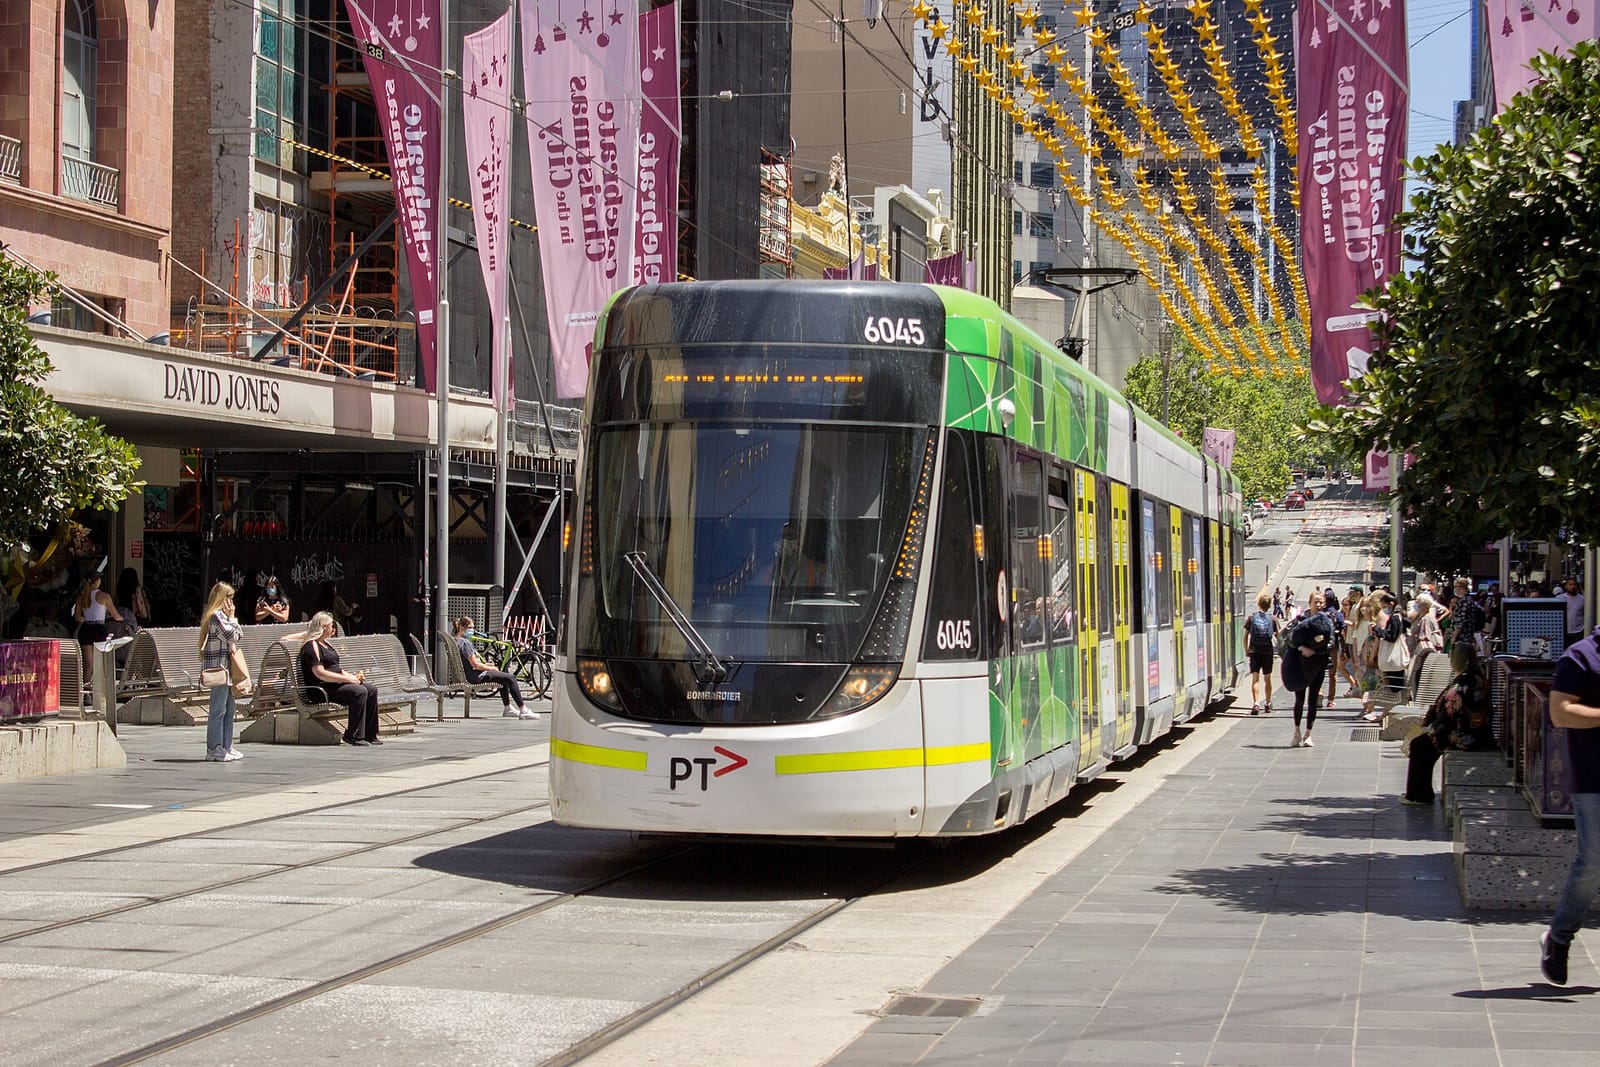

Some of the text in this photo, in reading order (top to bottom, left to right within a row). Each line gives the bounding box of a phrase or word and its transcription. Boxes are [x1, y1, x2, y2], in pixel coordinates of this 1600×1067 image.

[1115, 14, 1134, 30] 38
[368, 45, 383, 60] 38
[863, 316, 925, 346] 6045
[163, 363, 280, 414] DAVID JONES
[936, 618, 971, 650] 6045
[686, 690, 741, 702] BOMBARDIER
[670, 756, 717, 792] PT
